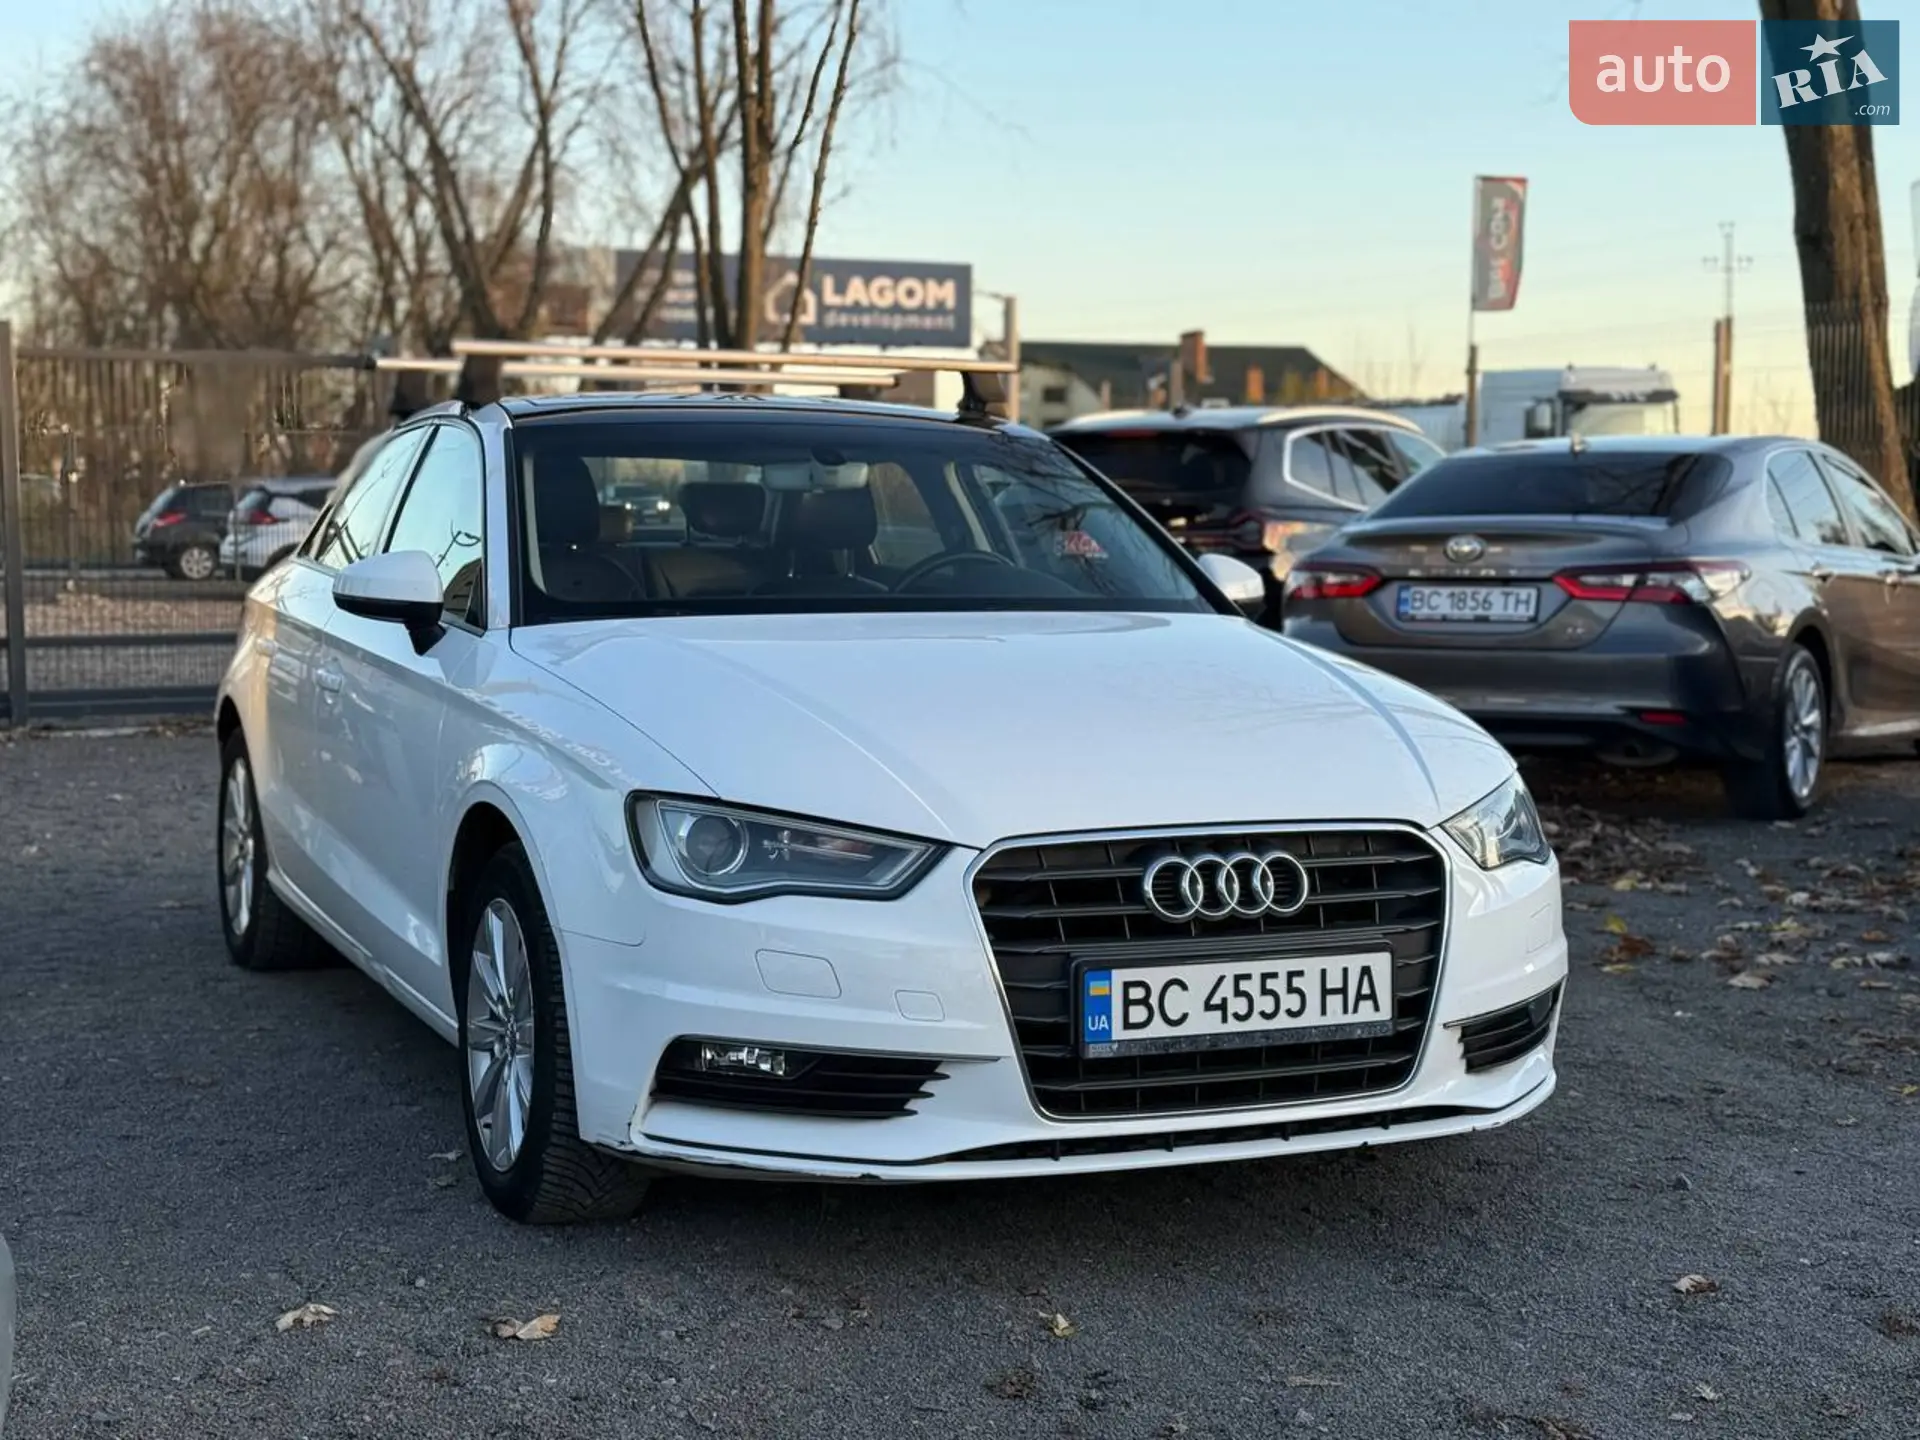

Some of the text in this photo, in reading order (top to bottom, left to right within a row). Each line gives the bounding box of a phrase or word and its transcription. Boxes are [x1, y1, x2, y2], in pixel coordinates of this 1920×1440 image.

[822, 275, 956, 309] LAGOM
[823, 311, 955, 331] development
[1411, 590, 1532, 612] BC 1856 TH
[1122, 965, 1380, 1031] BC 4555 HA
[1088, 1015, 1110, 1031] UA
